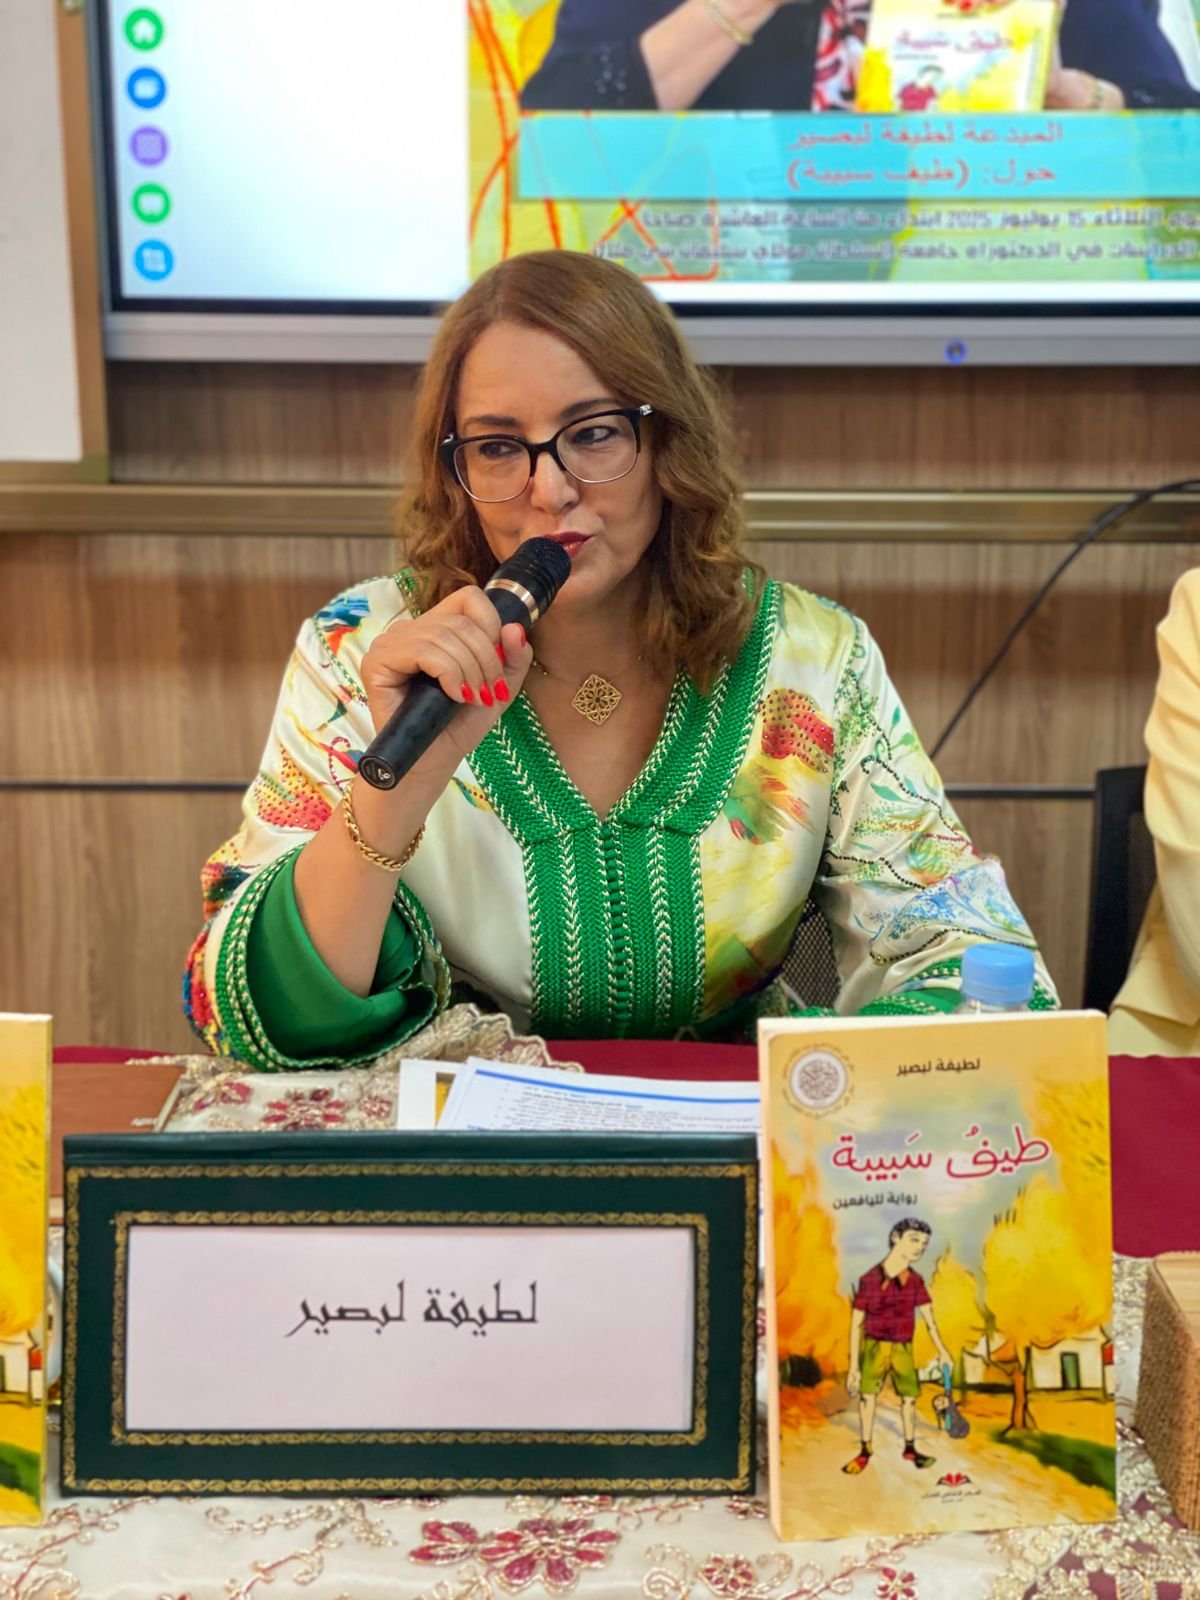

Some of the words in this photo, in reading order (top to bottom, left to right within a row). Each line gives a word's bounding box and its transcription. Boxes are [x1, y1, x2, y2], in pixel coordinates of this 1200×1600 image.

[935, 1058, 981, 1075] لطيفة
[284, 1279, 405, 1338] لبصير
[422, 1280, 538, 1337] لطيفة
